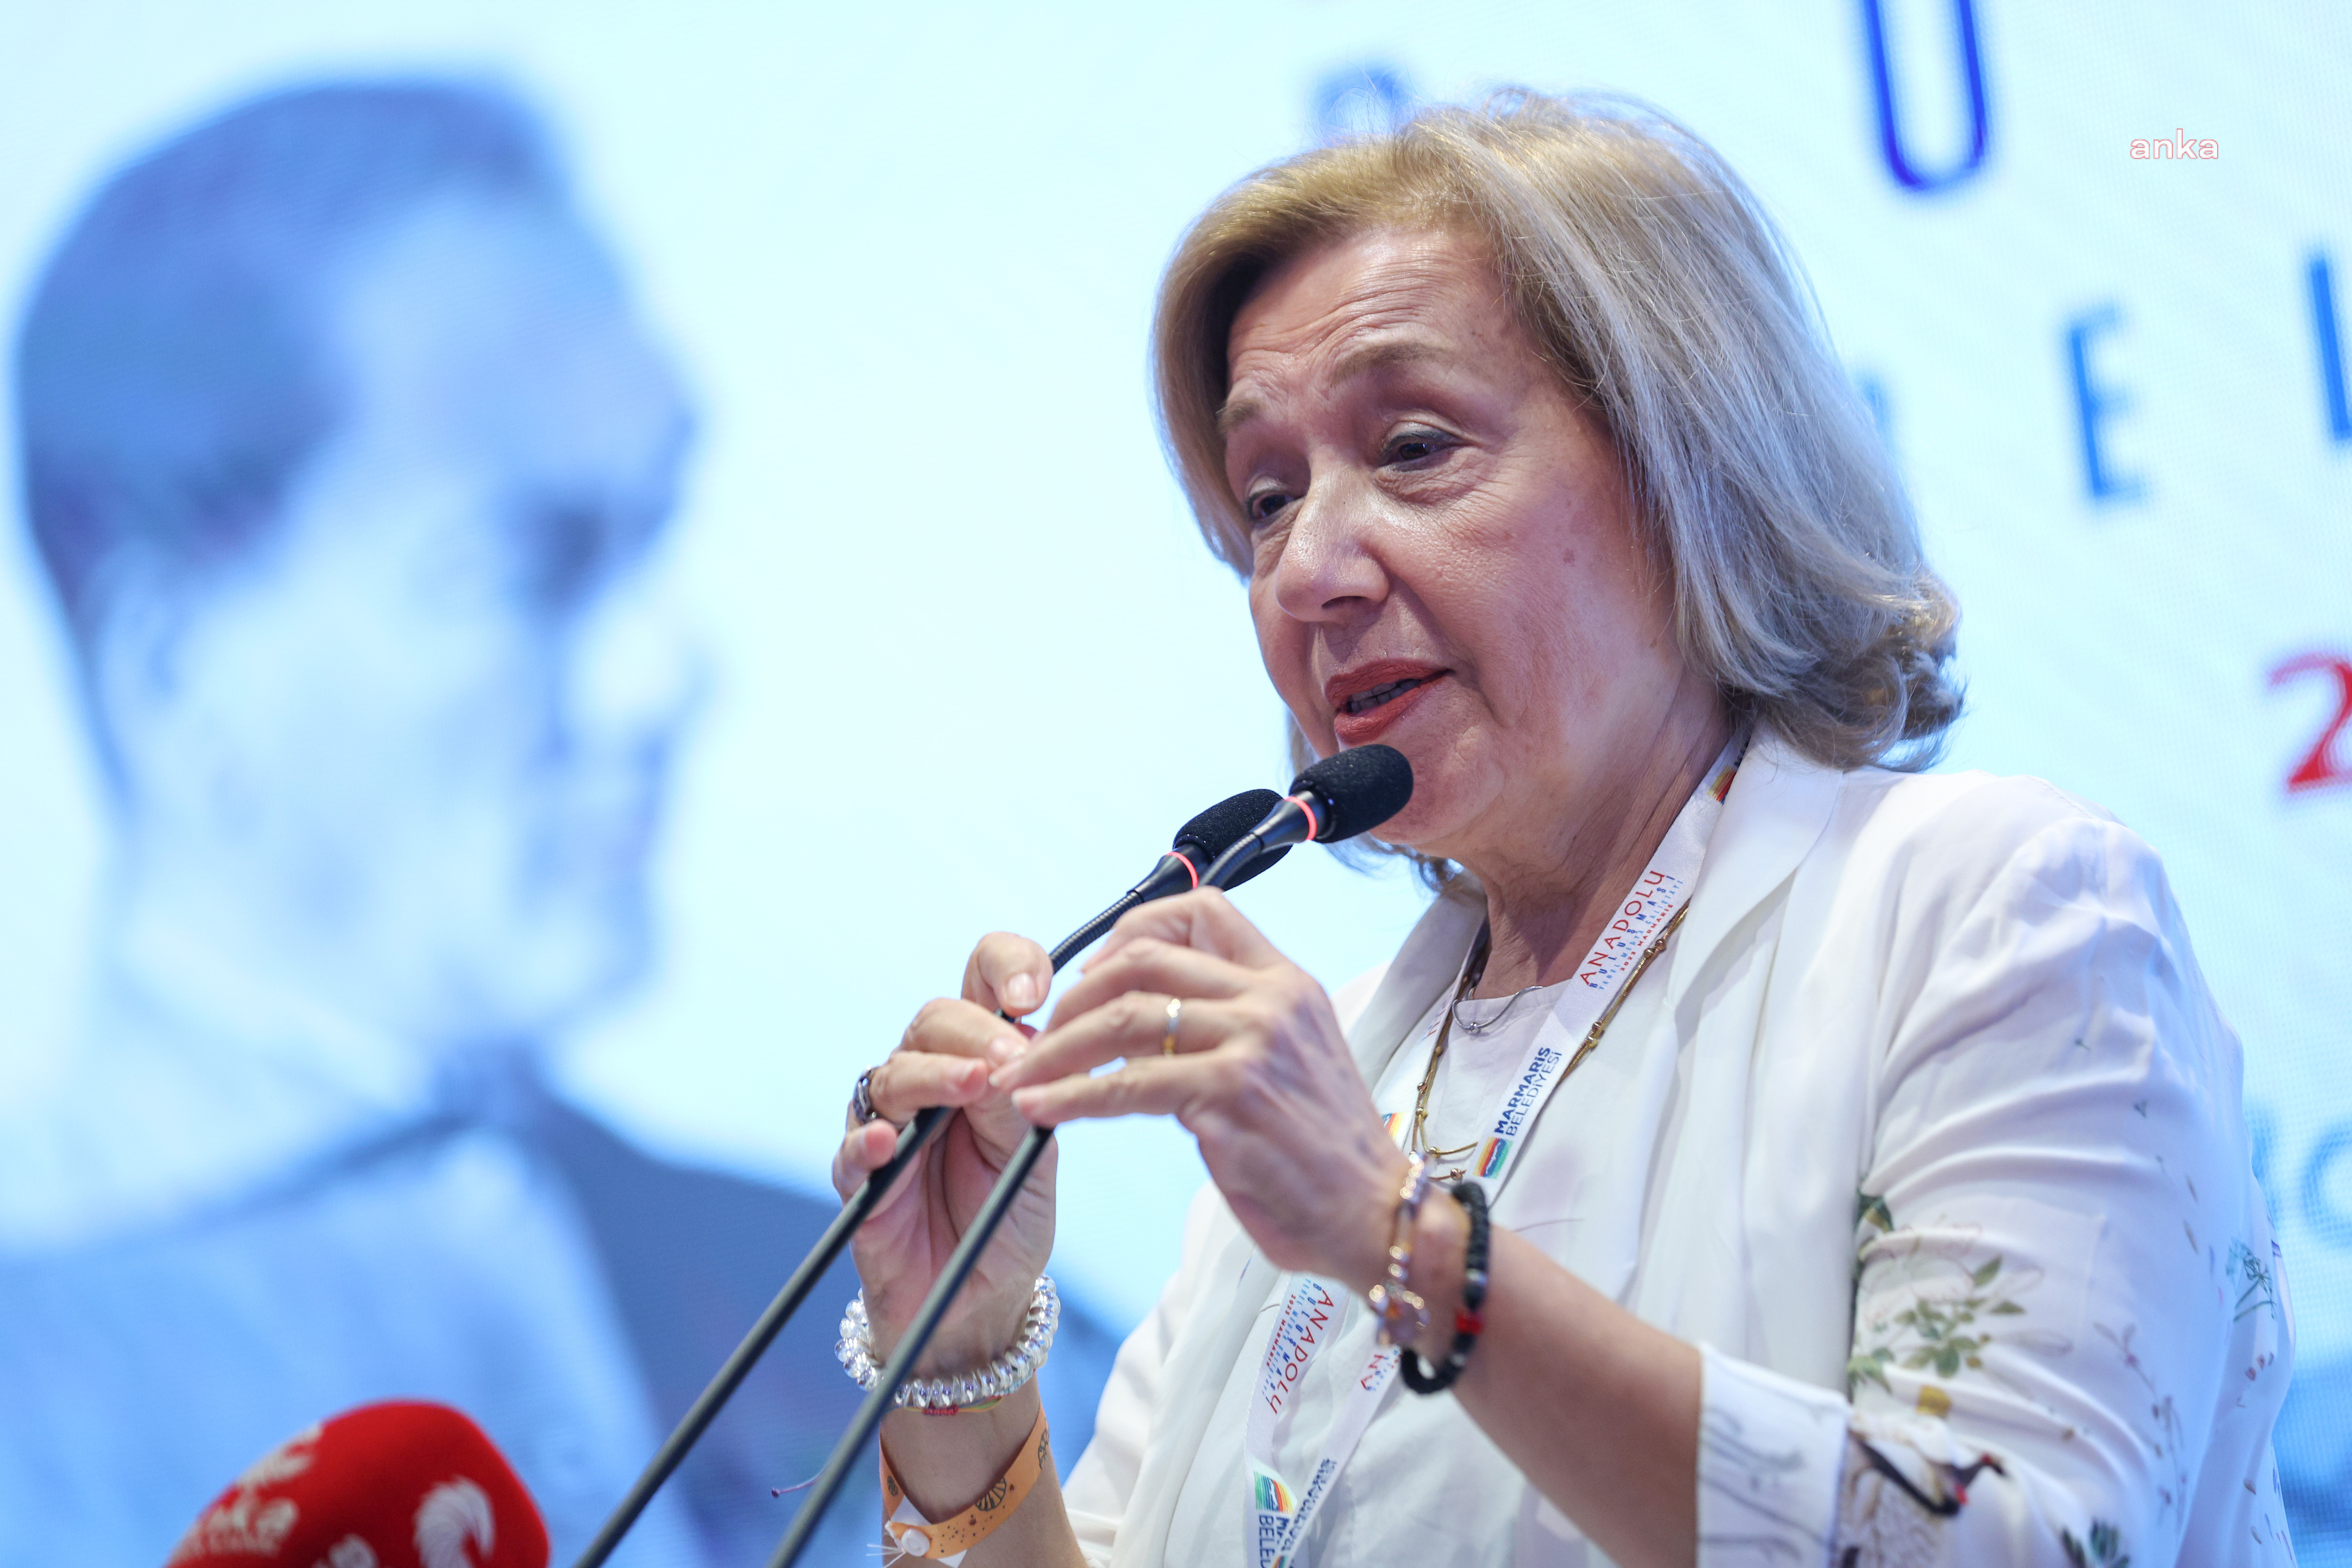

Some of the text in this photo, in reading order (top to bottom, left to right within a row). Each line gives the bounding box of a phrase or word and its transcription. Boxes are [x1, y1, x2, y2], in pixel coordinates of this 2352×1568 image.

[1580, 870, 1665, 985] ANADOLU
[1620, 951, 1636, 971] 2023
[1621, 930, 1644, 958] MEDYA
[1494, 1047, 1551, 1134] MARMARIS
[1270, 1289, 1334, 1414] ANADOLU
